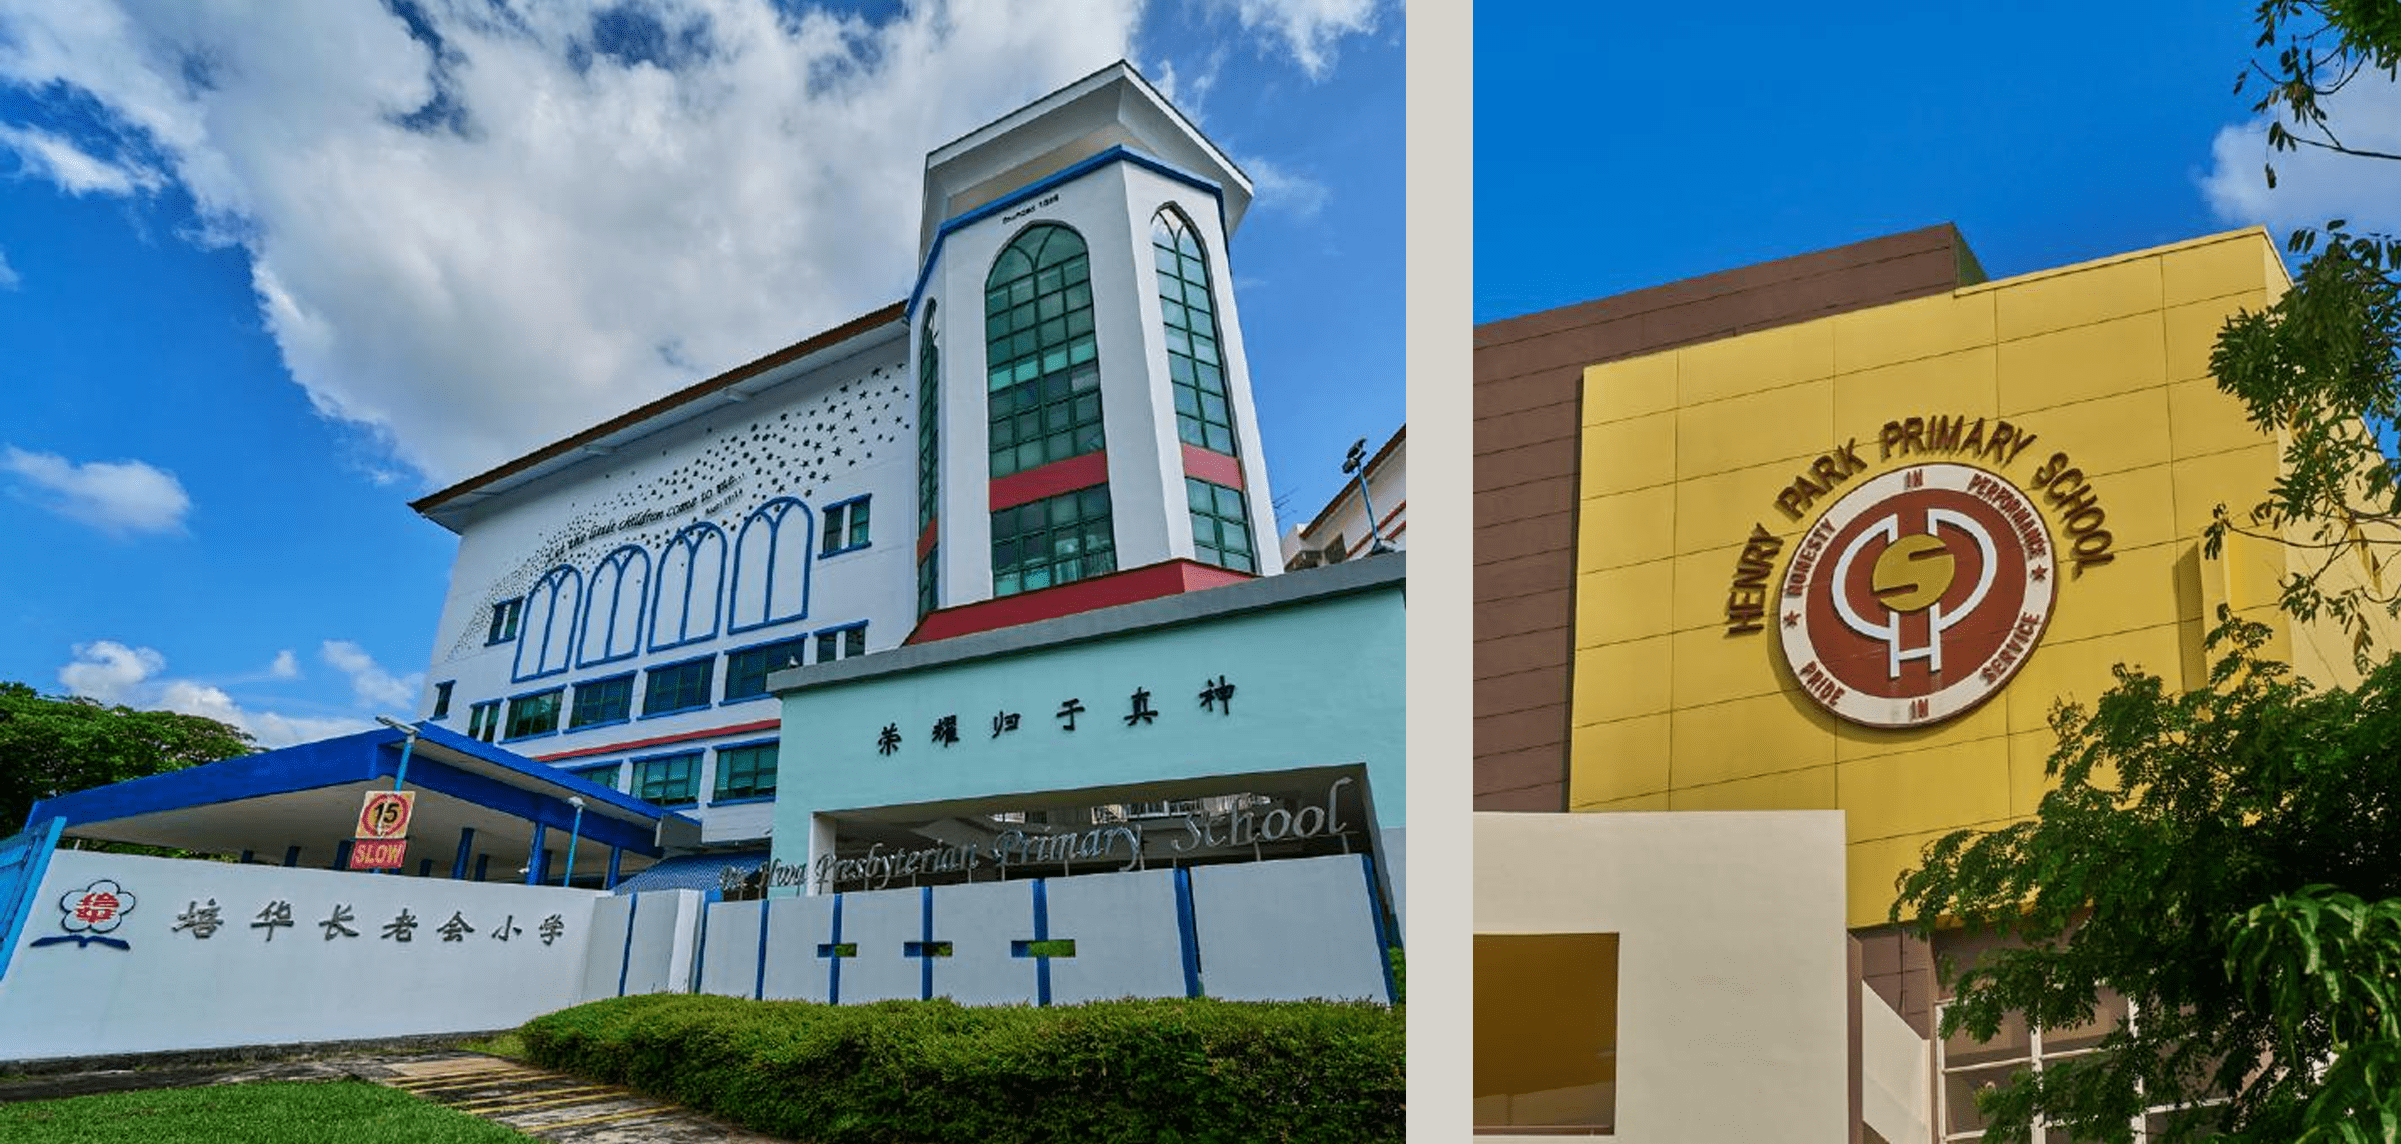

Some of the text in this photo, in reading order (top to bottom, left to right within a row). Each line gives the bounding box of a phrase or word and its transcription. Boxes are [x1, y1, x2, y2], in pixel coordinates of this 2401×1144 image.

[666, 497, 697, 518] come
[701, 489, 712, 502] to
[1726, 415, 2115, 637] HENRY PARK PRIMARY SCHOOL
[1786, 467, 2046, 597] HONESTY IN PERFORMANCE
[1800, 612, 2039, 720] PRIDE IN SERVICE
[877, 675, 1236, 756] 荣耀归于真神
[355, 844, 404, 864] SLOW
[374, 802, 400, 828] 15
[757, 857, 807, 890] Hwa
[815, 843, 980, 894] Presbyterian
[994, 823, 1142, 872] Primary
[1171, 776, 1352, 853] School
[172, 897, 566, 947] 培华长老会小学
